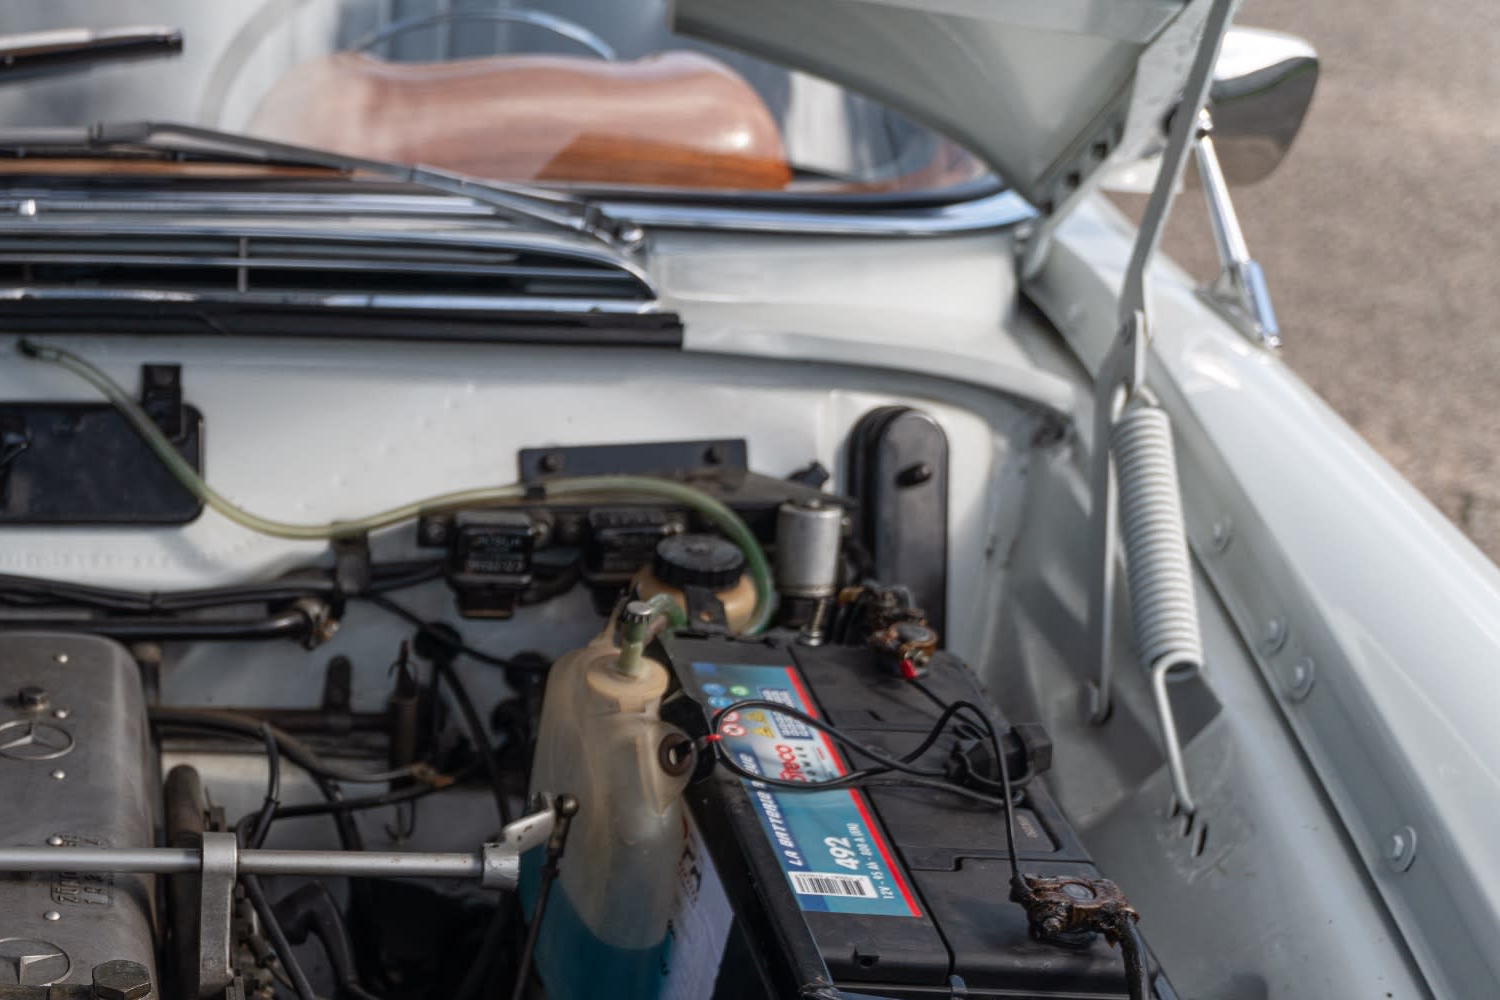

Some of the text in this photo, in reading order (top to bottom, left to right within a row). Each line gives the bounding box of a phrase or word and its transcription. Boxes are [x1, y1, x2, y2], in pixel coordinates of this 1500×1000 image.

[783, 849, 803, 867] LA
[823, 835, 860, 871] 492
[870, 870, 885, 880] 95
[878, 885, 896, 899] 12V
